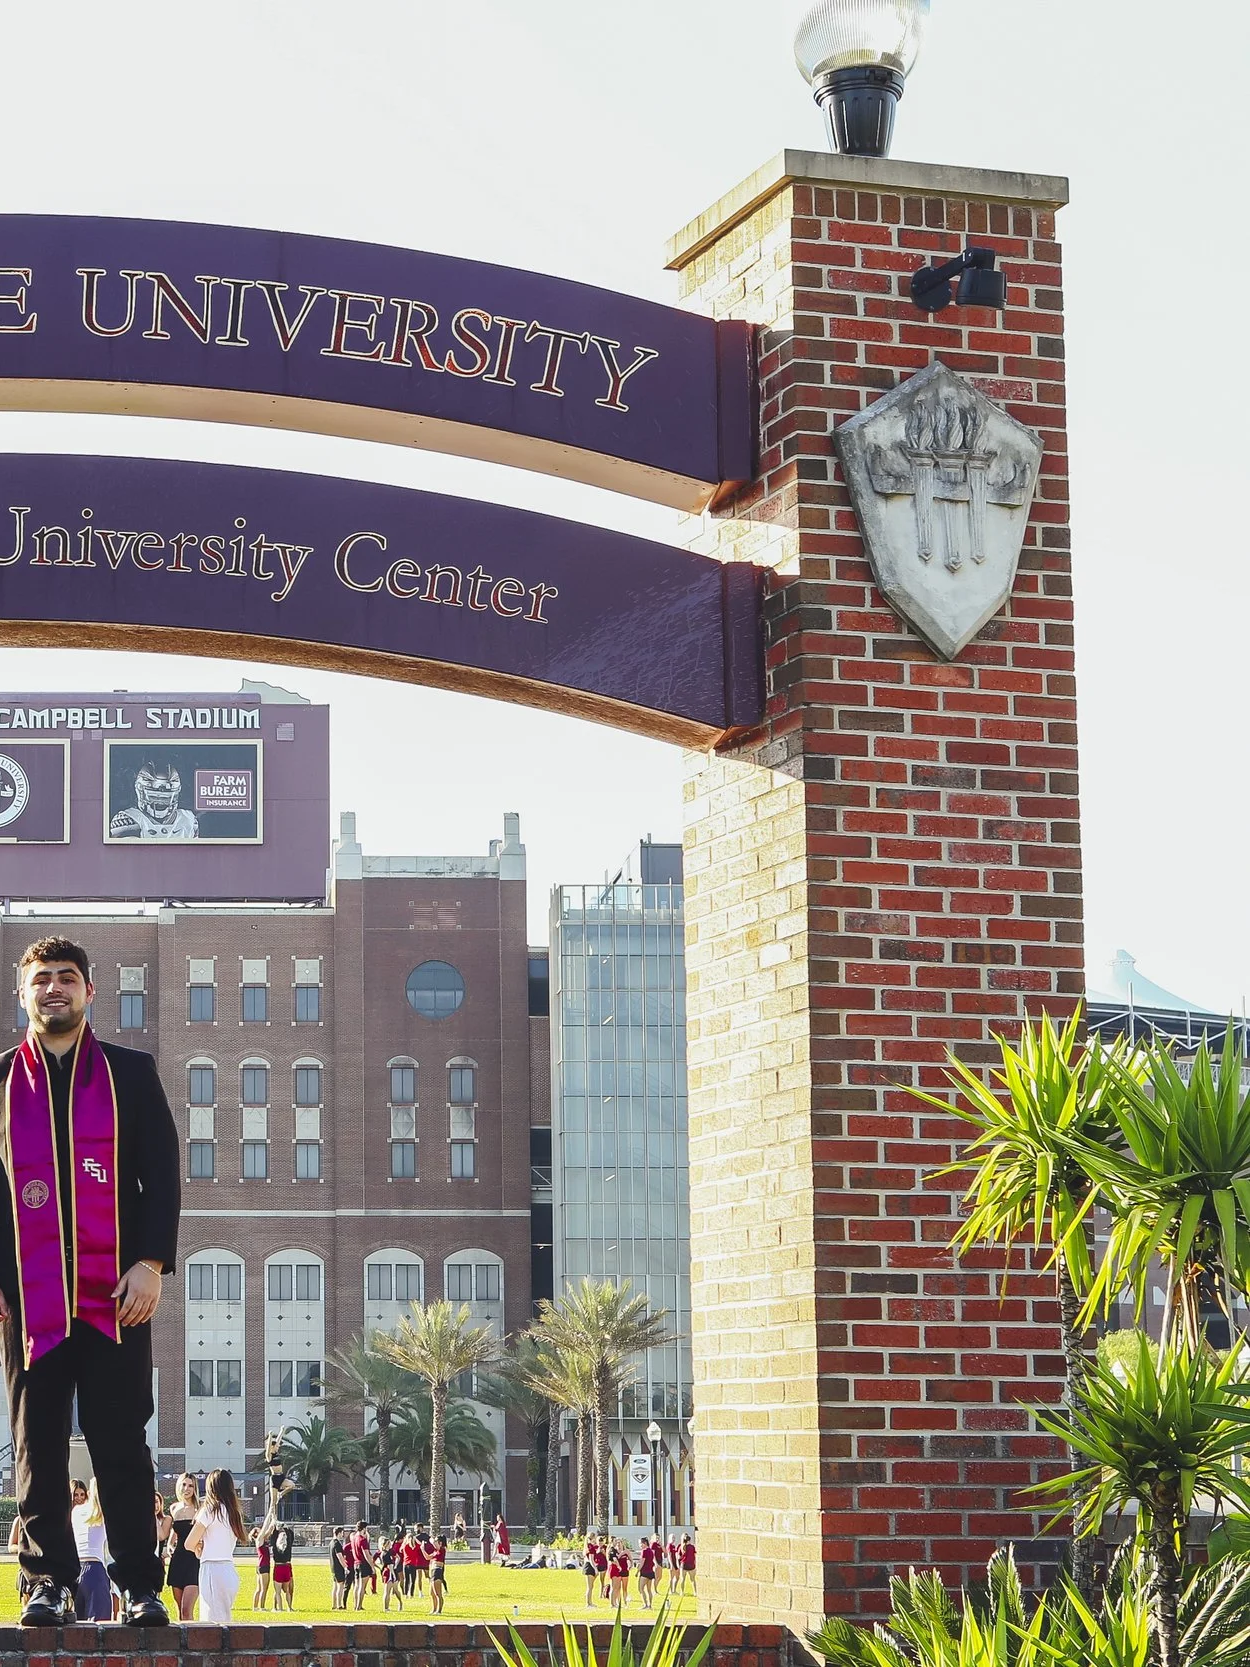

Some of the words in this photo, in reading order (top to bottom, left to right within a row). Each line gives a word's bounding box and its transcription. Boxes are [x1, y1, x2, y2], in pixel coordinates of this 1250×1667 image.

[76, 267, 659, 413] UNIVERSITY
[334, 532, 558, 625] Center
[145, 707, 261, 730] STADIUM
[1, 758, 25, 810] UNIVERSITY
[200, 786, 247, 796] BUREAU
[213, 775, 247, 786] FARM
[206, 799, 247, 807] INSURANCE
[82, 1158, 108, 1183] FSU
